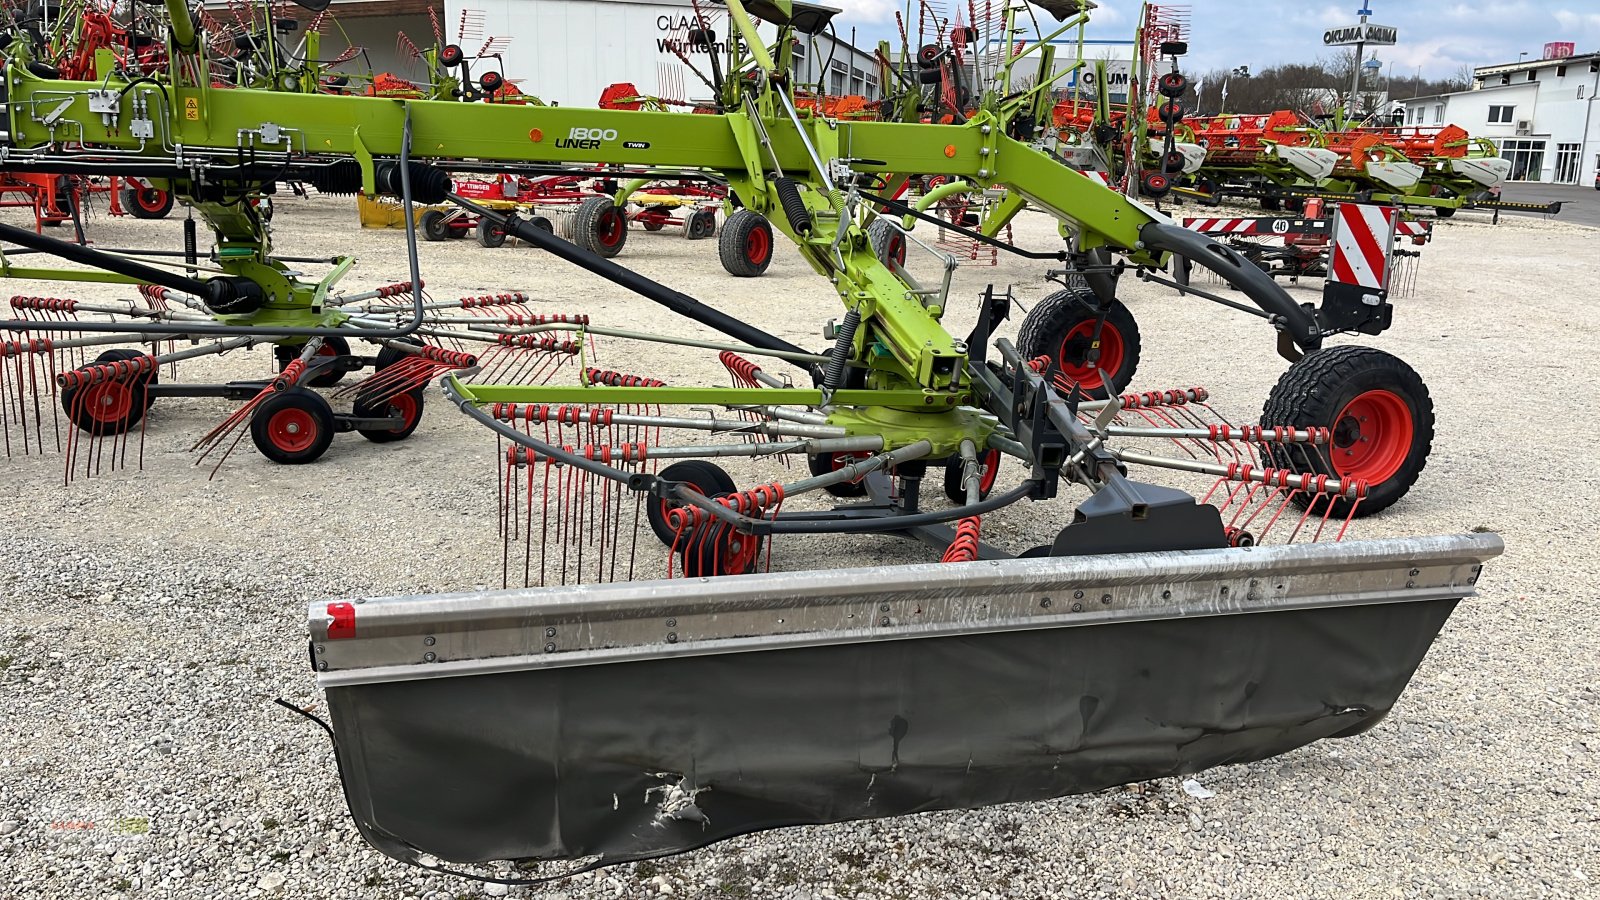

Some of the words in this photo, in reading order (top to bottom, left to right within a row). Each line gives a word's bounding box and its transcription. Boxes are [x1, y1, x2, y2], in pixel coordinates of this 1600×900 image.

[656, 15, 711, 31] CLAAS
[1323, 27, 1364, 44] OKUMA
[1365, 26, 1397, 43] OKUMA
[567, 127, 618, 141] 1800
[554, 138, 601, 150] LINER
[1274, 220, 1287, 232] 40
